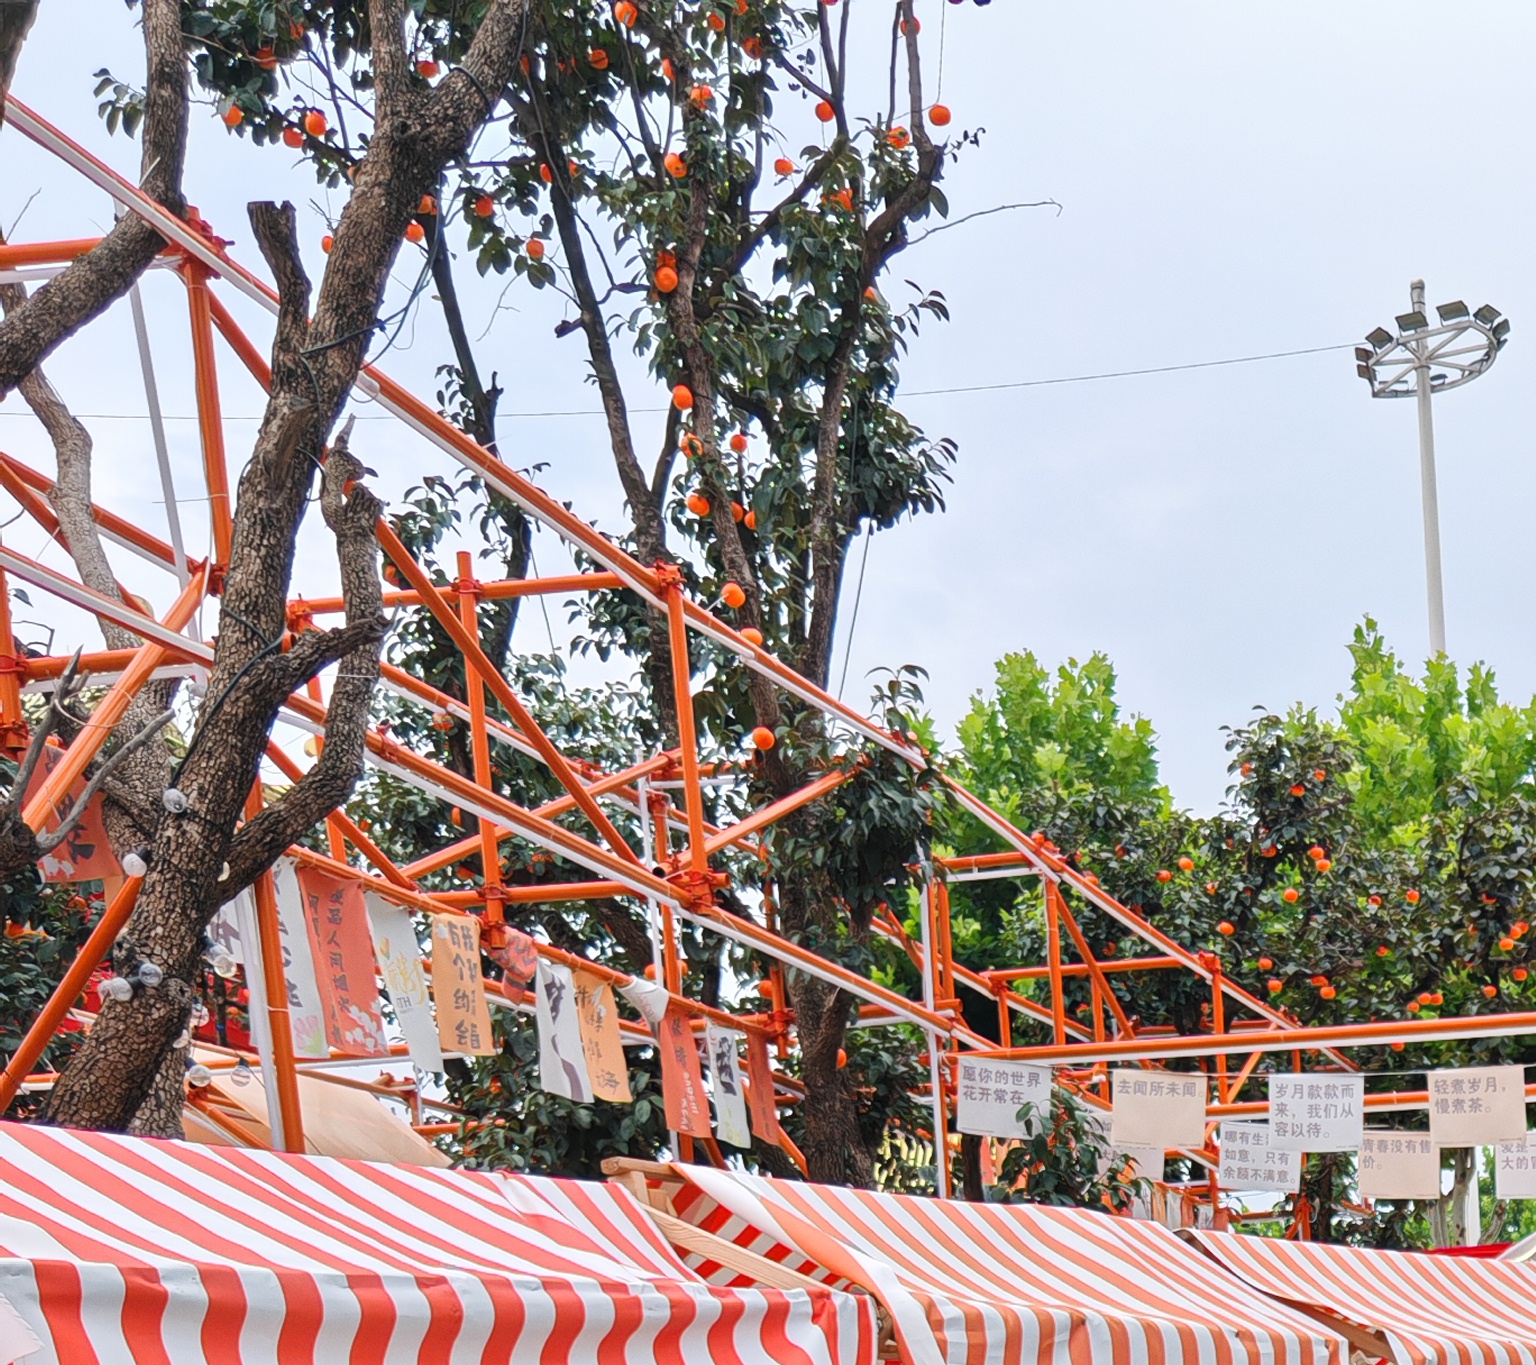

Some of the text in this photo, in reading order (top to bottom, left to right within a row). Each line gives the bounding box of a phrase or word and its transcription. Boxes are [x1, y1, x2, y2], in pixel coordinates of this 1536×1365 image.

[962, 1066, 1042, 1089] 愿你的世界
[1433, 1076, 1507, 1094] 轻煮岁月，
[962, 1085, 1025, 1105] 花开常在
[1117, 1079, 1204, 1098] 去闻所未闻。
[1275, 1083, 1356, 1100] 岁月款款而
[1274, 1103, 1355, 1119] 来，我们从
[1434, 1097, 1492, 1115] 慢煮茶。
[1274, 1122, 1331, 1139] 容以待。
[1363, 1139, 1432, 1154] 青春没有售
[1224, 1148, 1291, 1166] 如意，只有
[1362, 1155, 1383, 1170] 价。
[1223, 1166, 1296, 1184] 余额不满意。
